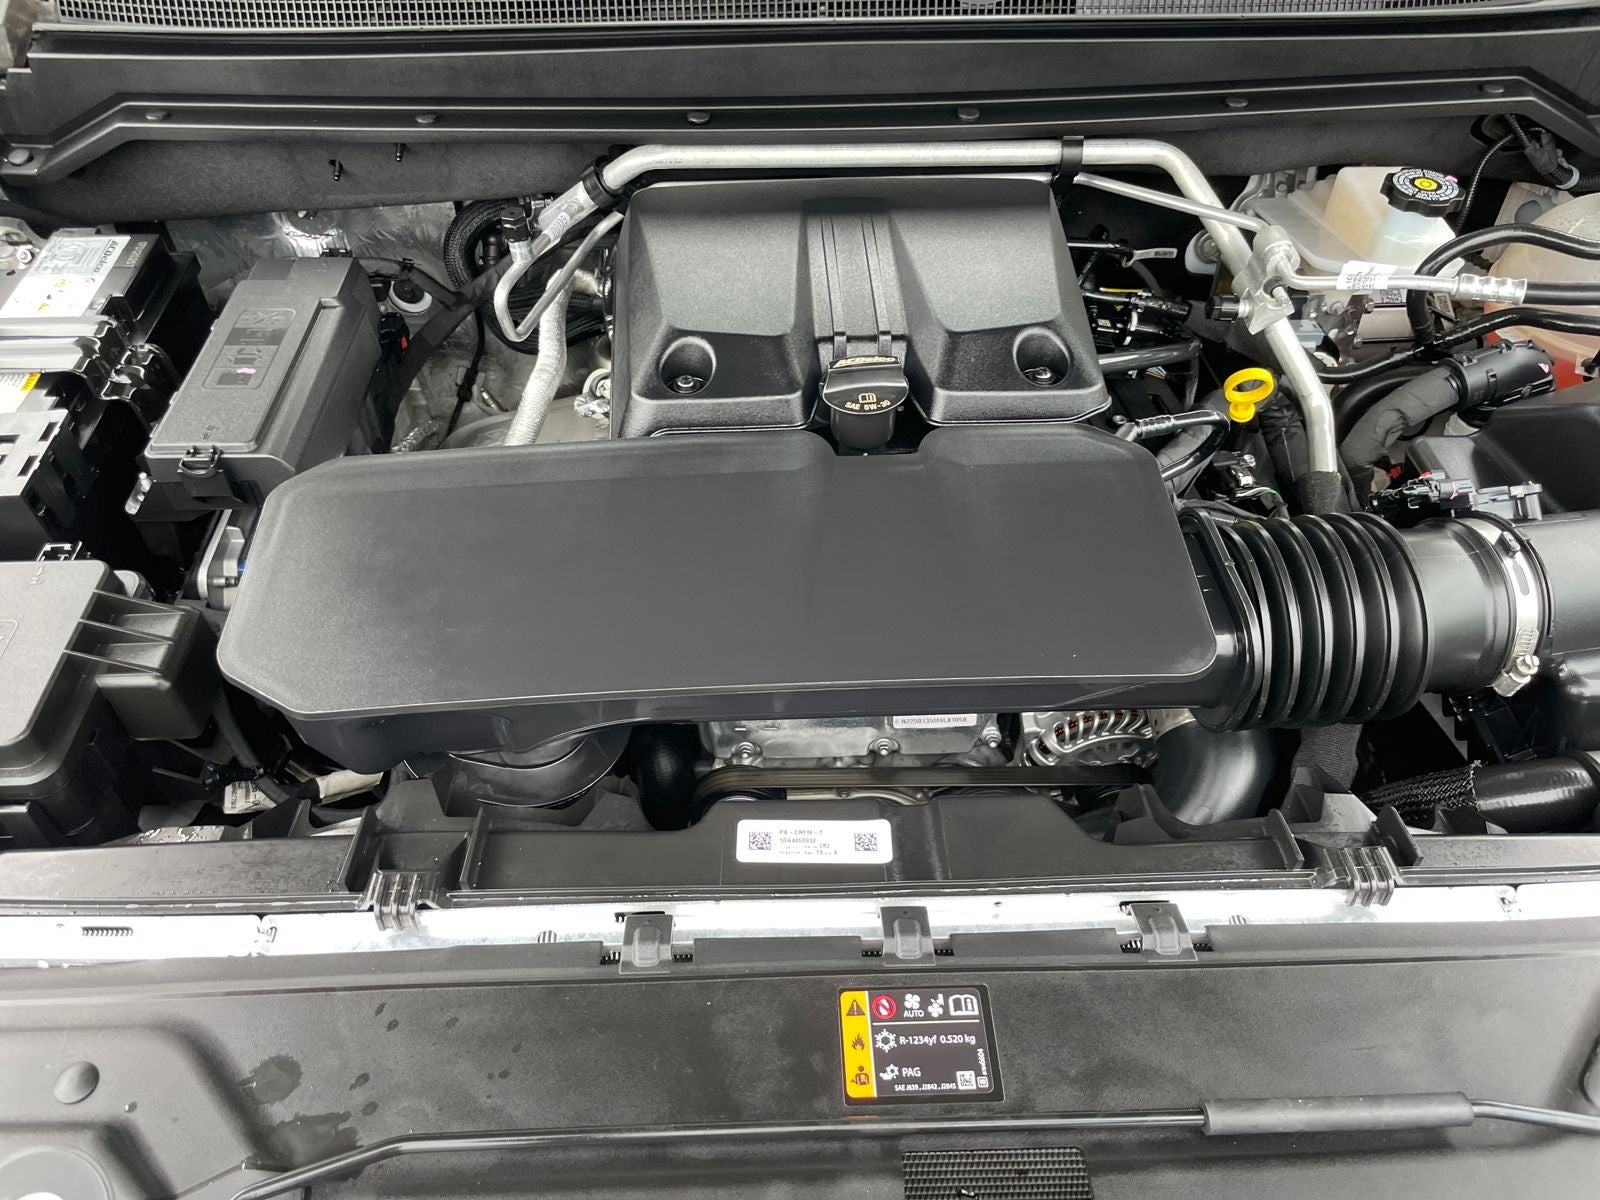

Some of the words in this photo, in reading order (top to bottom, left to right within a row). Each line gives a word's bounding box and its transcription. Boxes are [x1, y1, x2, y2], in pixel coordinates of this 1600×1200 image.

[94, 240, 118, 273] ACDelco
[832, 356, 896, 368] ACDelco
[844, 402, 861, 410] SAE
[863, 399, 891, 411] 5W-30
[903, 1010, 925, 1018] AUTO
[899, 1035, 938, 1046] R-1234yf
[940, 1034, 963, 1043] 0.520
[965, 1034, 976, 1045] kg
[902, 1067, 922, 1077] PAG
[894, 1084, 906, 1092] SAE
